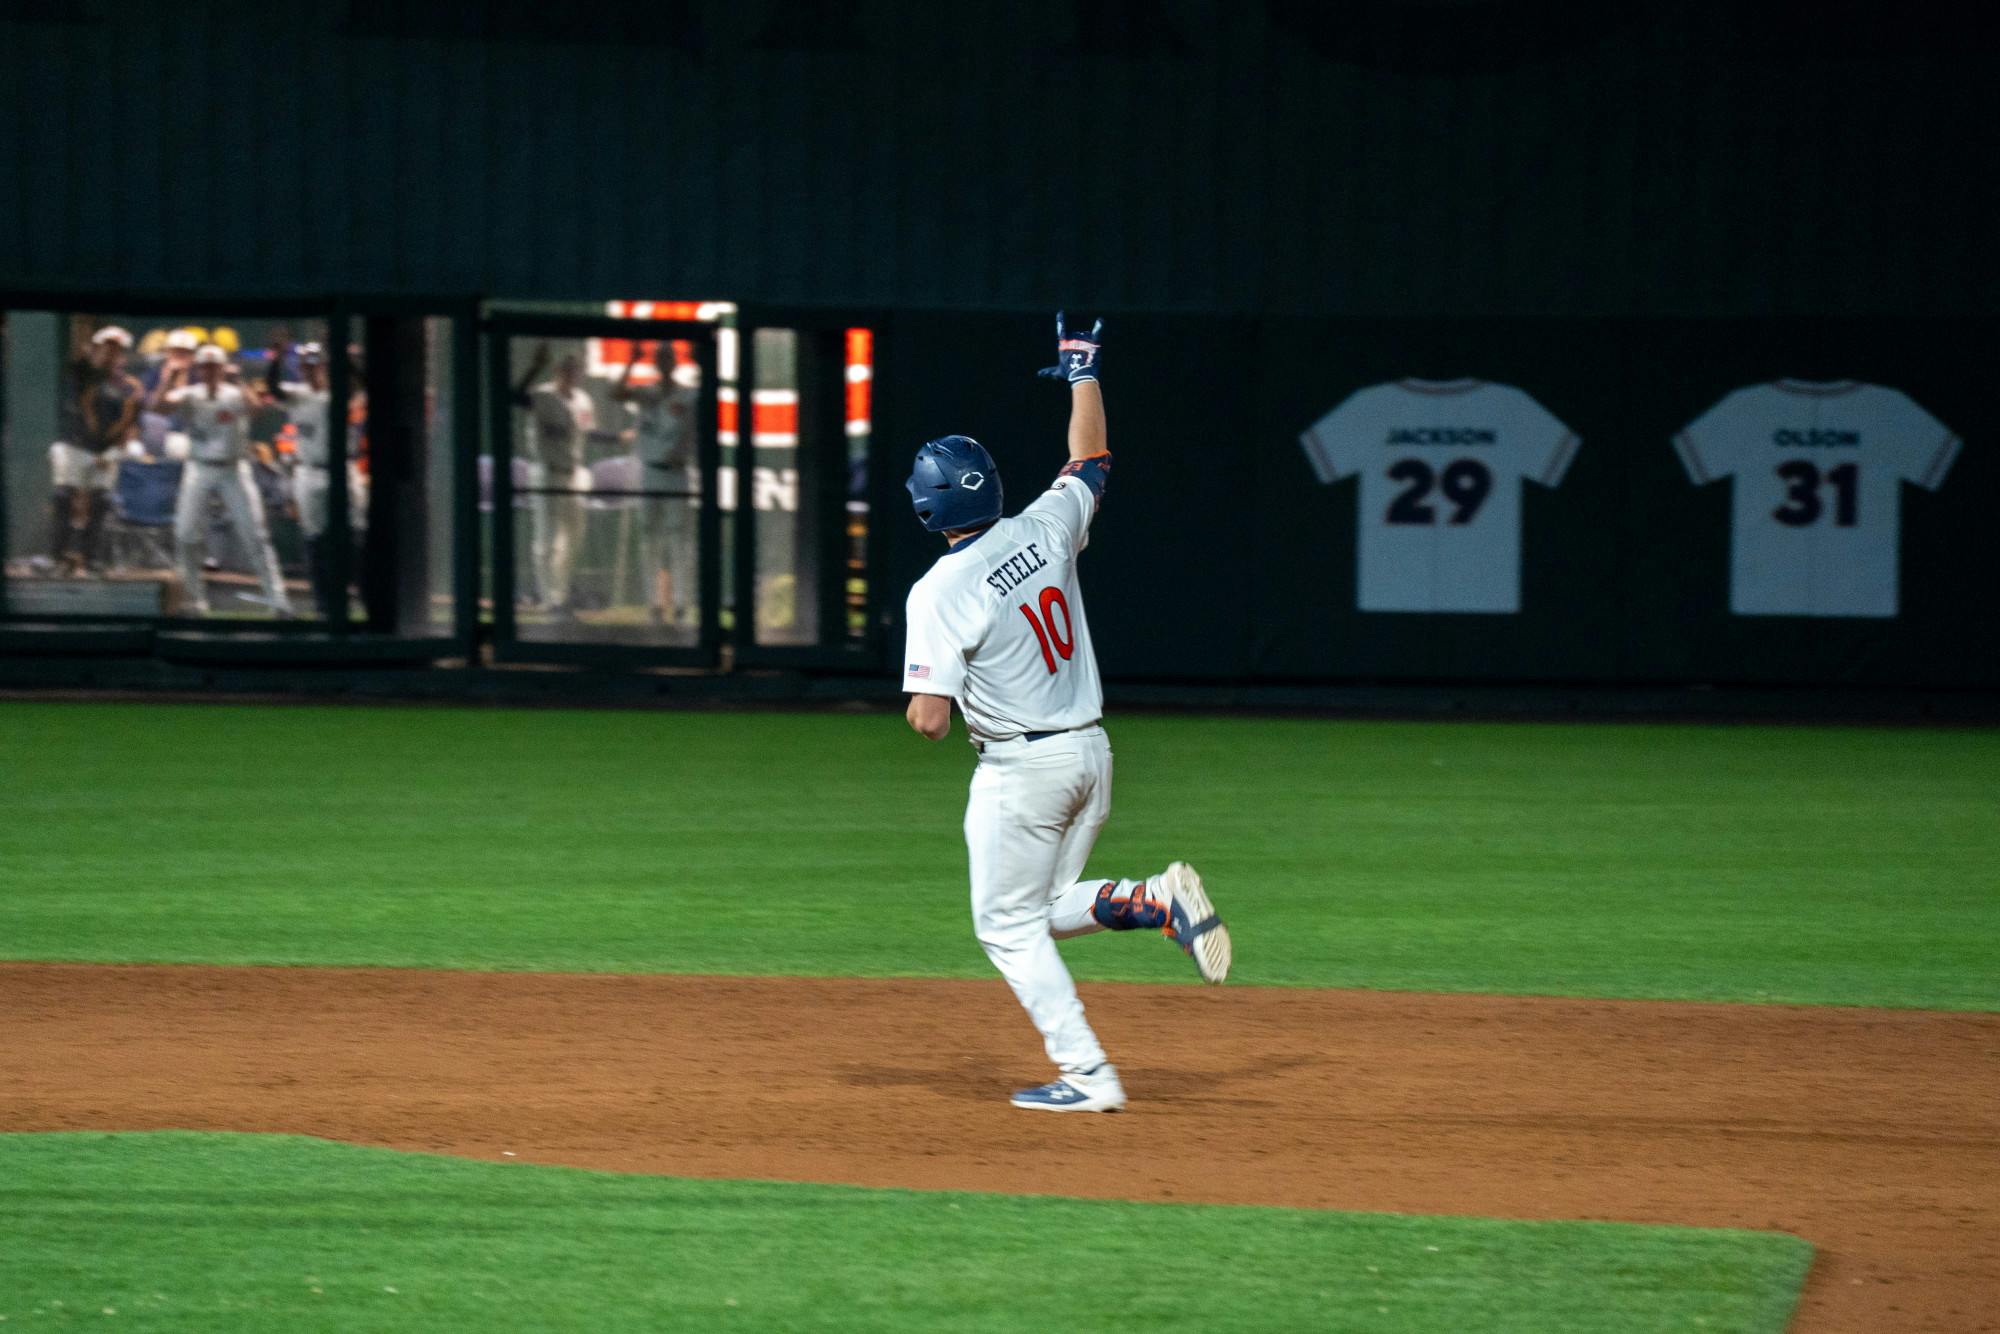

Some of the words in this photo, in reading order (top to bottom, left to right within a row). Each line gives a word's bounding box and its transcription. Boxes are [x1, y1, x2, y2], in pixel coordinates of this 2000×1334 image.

[1386, 428, 1496, 446] JACKSON
[1774, 428, 1860, 447] OLSON
[1385, 458, 1492, 525] 29
[1773, 461, 1858, 527] 31
[986, 542, 1048, 597] STEELE
[1018, 586, 1074, 676] 10
